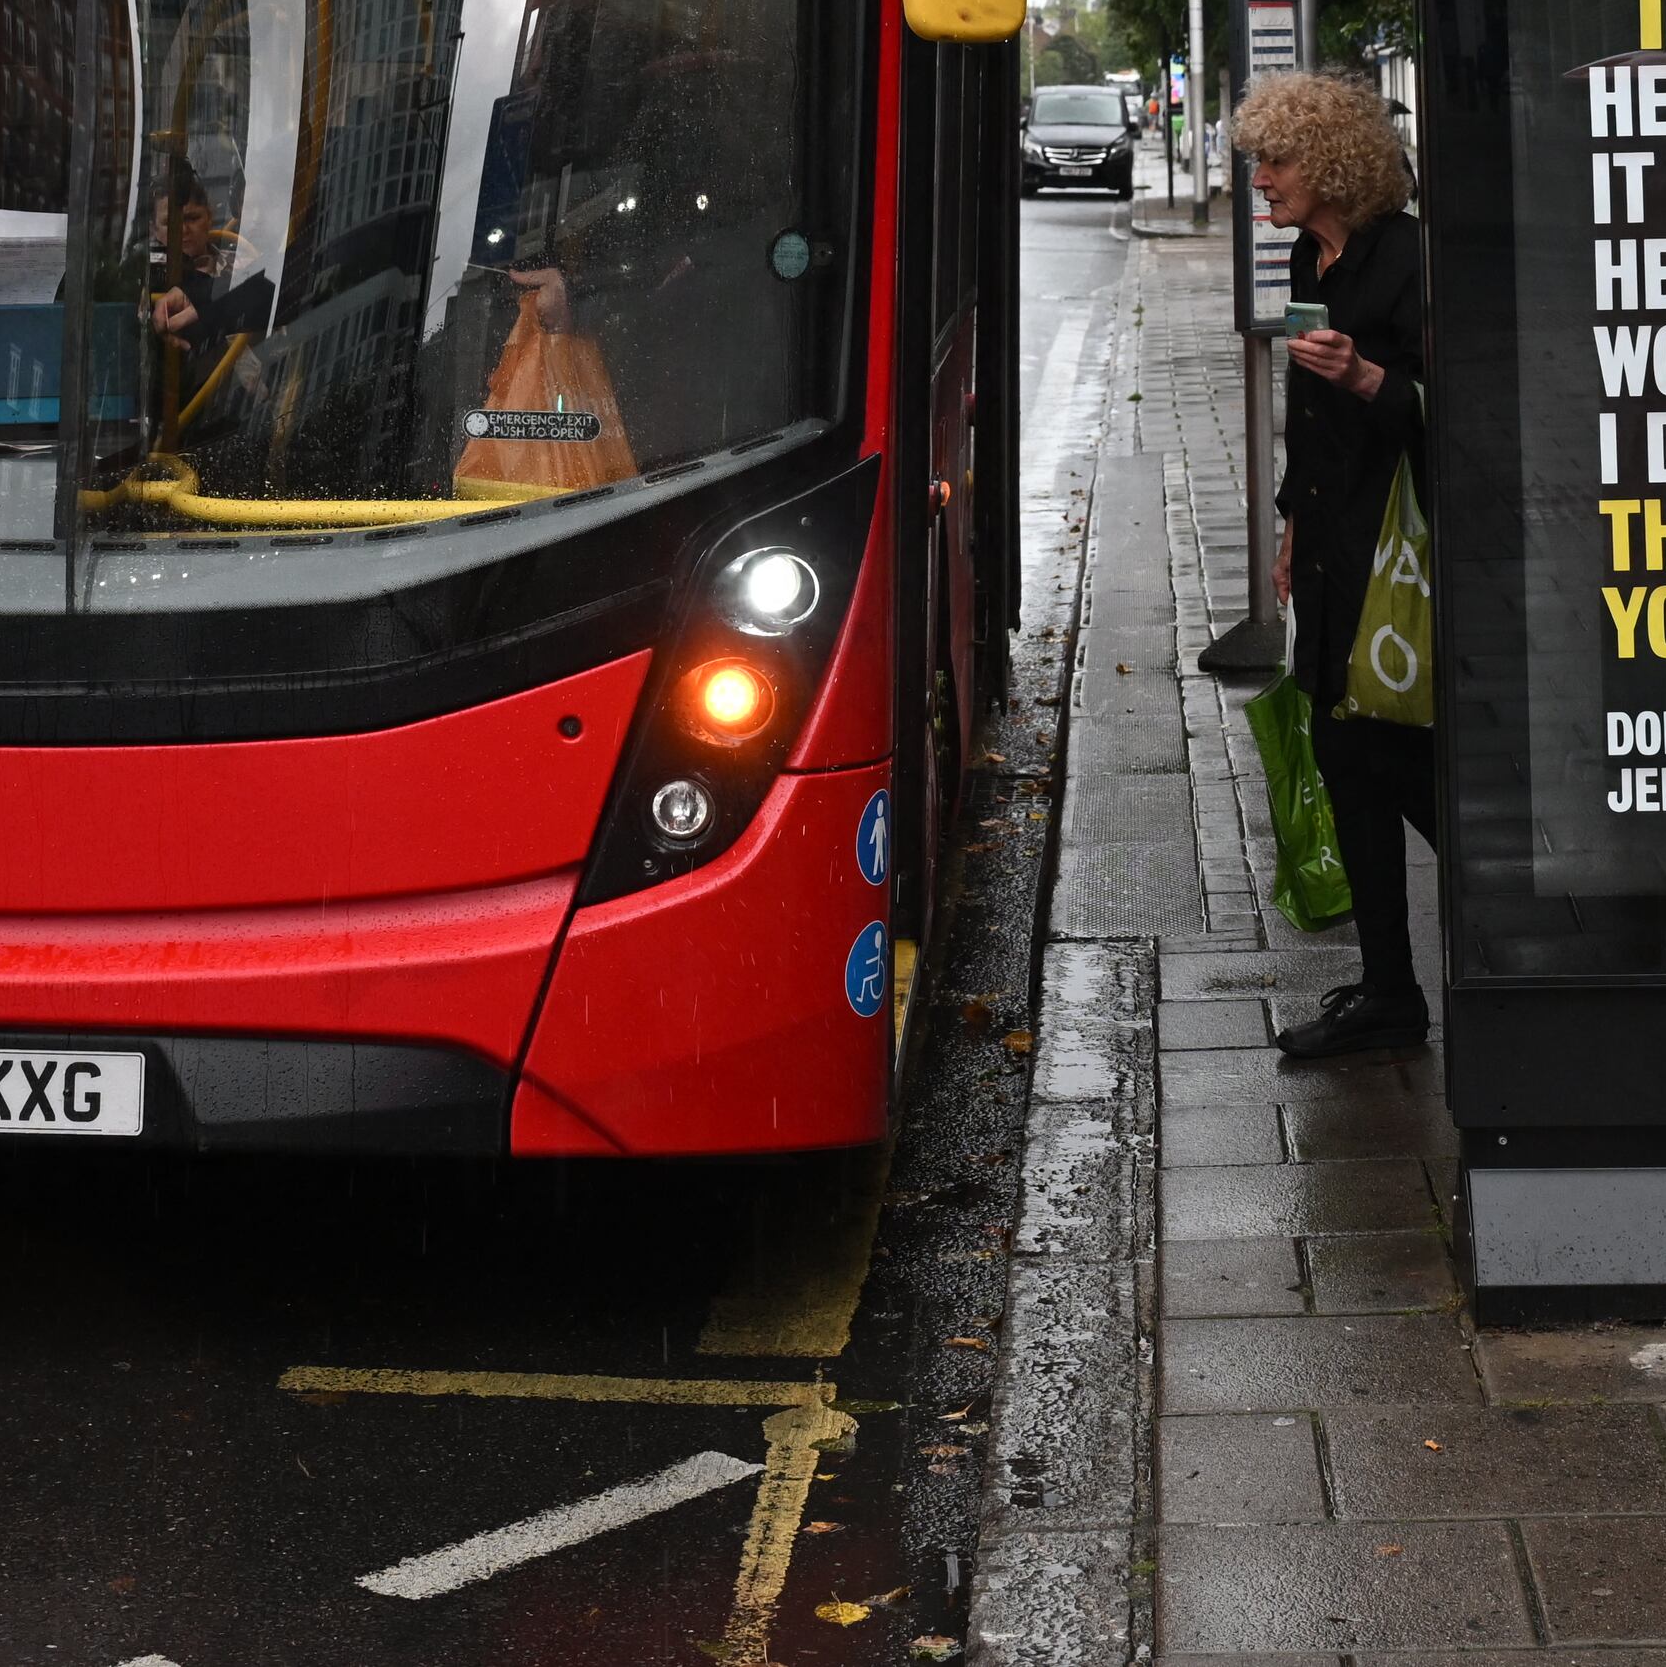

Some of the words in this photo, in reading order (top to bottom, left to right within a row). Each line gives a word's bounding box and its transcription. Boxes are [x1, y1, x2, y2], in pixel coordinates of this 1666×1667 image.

[1592, 152, 1655, 225] IT
[489, 413, 564, 426] EMERGENCY
[567, 415, 593, 427] EXIT
[493, 426, 526, 437] PUSH
[528, 427, 547, 438] TO
[549, 427, 584, 439] OPEN
[1599, 412, 1619, 485] I
